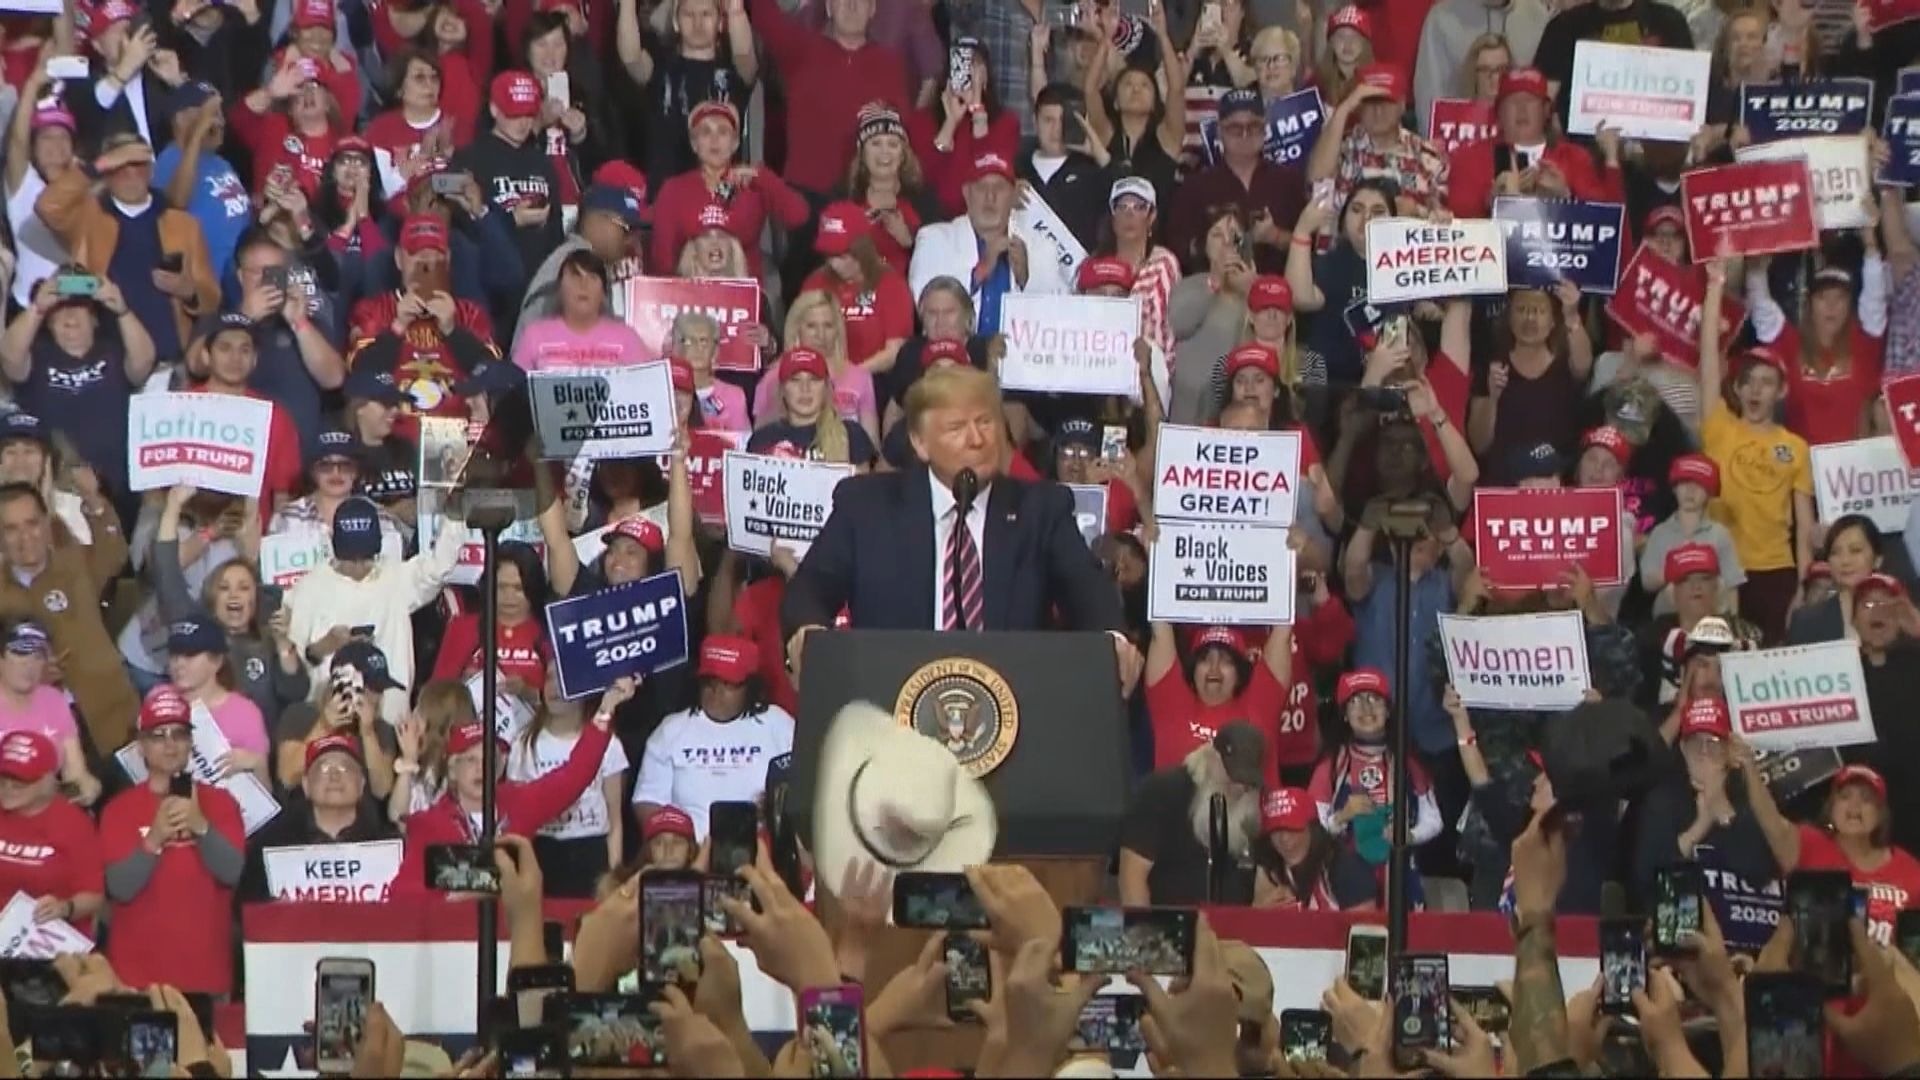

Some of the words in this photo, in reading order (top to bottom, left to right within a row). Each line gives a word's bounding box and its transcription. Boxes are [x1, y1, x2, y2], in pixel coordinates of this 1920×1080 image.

[1749, 94, 1866, 112] TRUMP
[1776, 118, 1839, 133] 2020
[1692, 183, 1800, 213] TRUMP
[1405, 228, 1465, 245] KEEP
[1502, 220, 1616, 243] TRUMP
[1376, 246, 1498, 270] AMERICA
[1527, 251, 1588, 269] 2020
[1395, 266, 1479, 287] GREAT!
[1011, 318, 1128, 353] Women
[553, 380, 610, 405] Black
[586, 401, 650, 423] Voices
[141, 412, 255, 446] Latinos
[600, 424, 649, 437] TRUMP
[143, 447, 179, 464] FOR
[184, 447, 250, 470] TRUMP
[1196, 441, 1259, 466] KEEP
[743, 469, 788, 496] Black
[1162, 464, 1290, 493] AMERICA
[765, 495, 825, 523] Voices
[1180, 494, 1269, 516] GREAT!
[1486, 516, 1609, 537] TRUMP
[1175, 534, 1229, 559] Black
[1498, 537, 1599, 552] PENCE
[1205, 558, 1268, 583] Voices
[1179, 587, 1210, 599] FOR
[1216, 588, 1265, 600] TRUMP
[558, 596, 678, 643] TRUMP
[595, 636, 657, 667] 2020
[1451, 636, 1574, 673] Women
[1471, 673, 1502, 686] FOR
[1508, 673, 1565, 688] TRUMP
[1734, 668, 1852, 704] Latinos
[1744, 710, 1784, 728] FOR
[1788, 703, 1853, 723] TRUMP
[682, 746, 762, 759] TRUMP
[305, 860, 361, 879] KEEP
[1730, 905, 1780, 925] 2020
